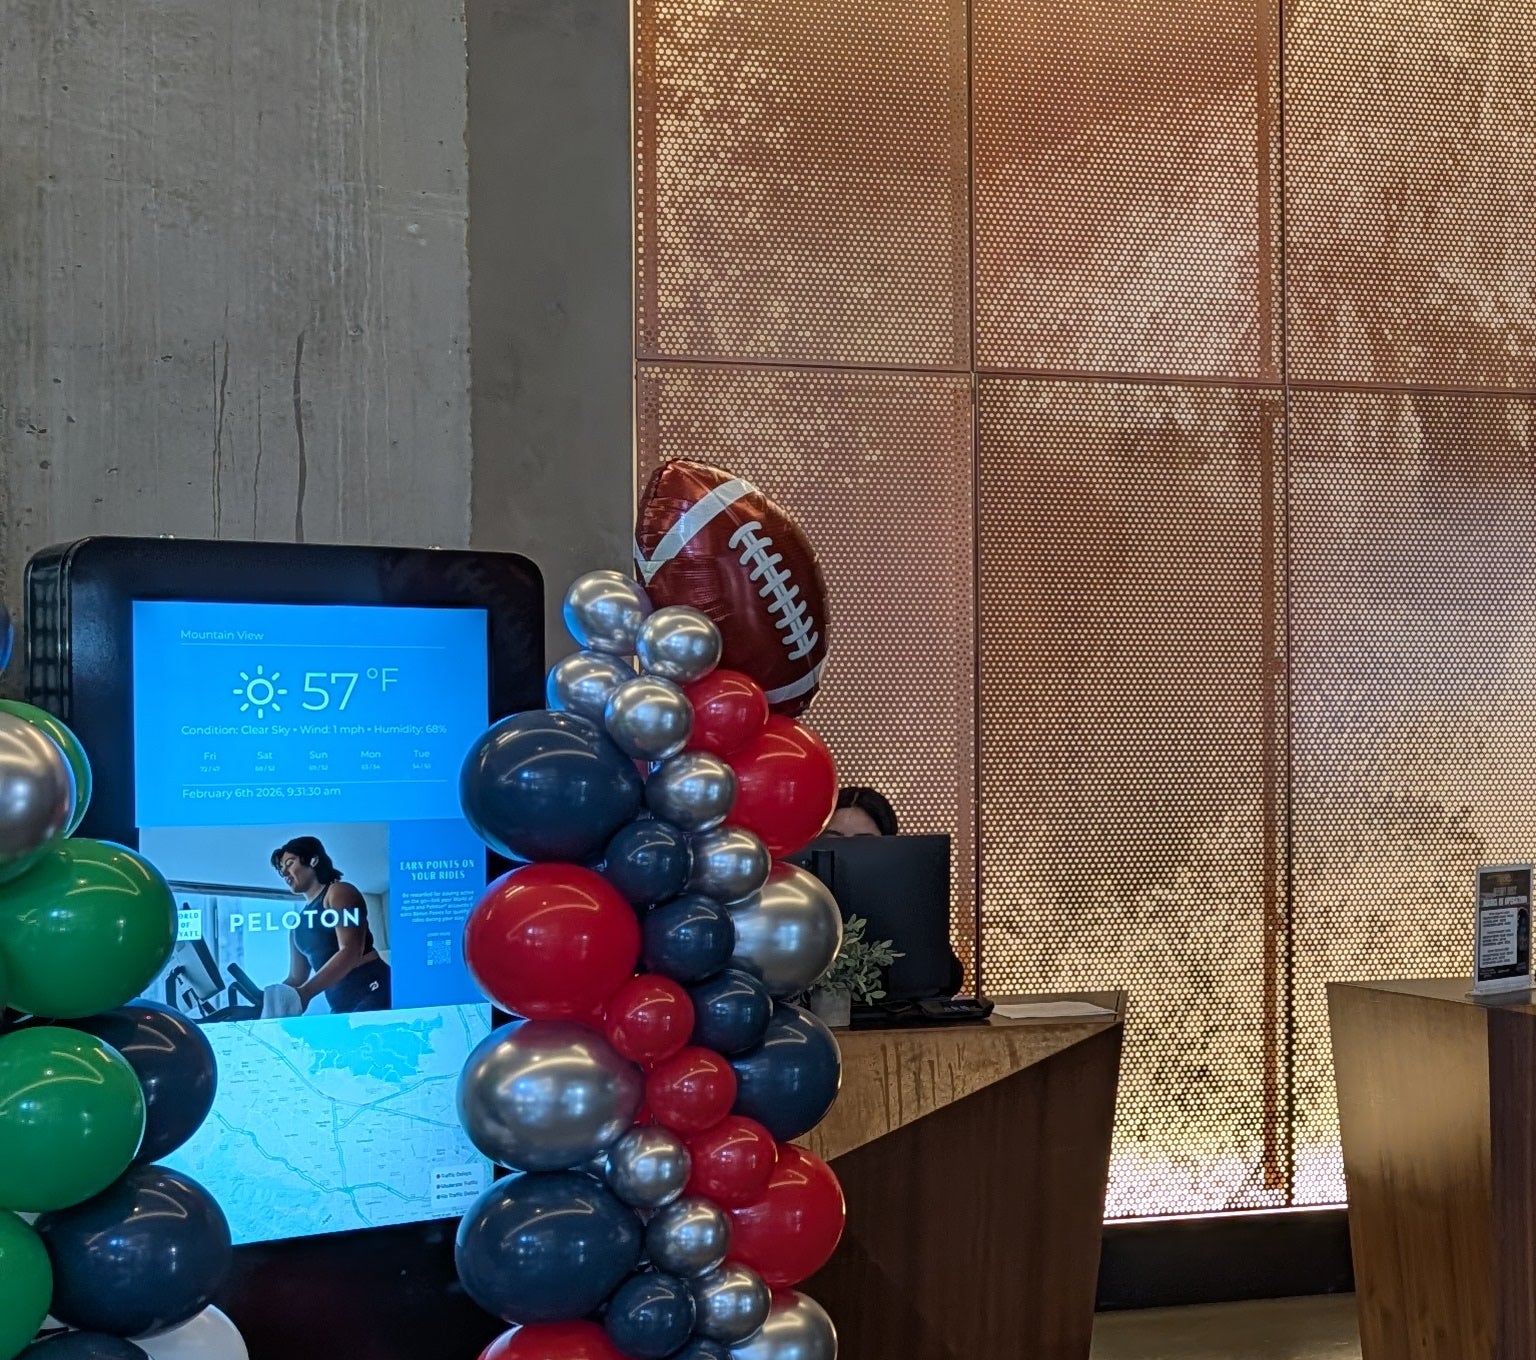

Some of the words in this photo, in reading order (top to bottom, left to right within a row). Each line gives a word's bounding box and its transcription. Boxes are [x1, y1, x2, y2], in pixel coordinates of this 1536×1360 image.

[180, 629, 234, 640] Mountain
[236, 630, 264, 640] View
[302, 672, 359, 711] 57
[181, 725, 238, 736] Condition:
[240, 725, 269, 735] Clear
[271, 725, 291, 736] Sky
[300, 725, 331, 735] Wind:
[340, 725, 365, 737] mph
[374, 724, 424, 736] Humidity:
[426, 724, 448, 735] 68%
[203, 752, 217, 761] Fri
[257, 751, 273, 760] Sat
[309, 751, 328, 760] Sun
[360, 750, 381, 759] Mon
[413, 749, 431, 758] Tue
[182, 789, 233, 800] February
[234, 788, 254, 798] 6th
[256, 787, 285, 798] 2026,
[323, 788, 341, 796] am
[400, 861, 424, 871] EARN
[426, 860, 460, 870] POINTS
[462, 859, 475, 869] ON
[412, 872, 436, 881] YOUR
[439, 870, 466, 880] RIDES
[229, 907, 360, 933] PELOTON
